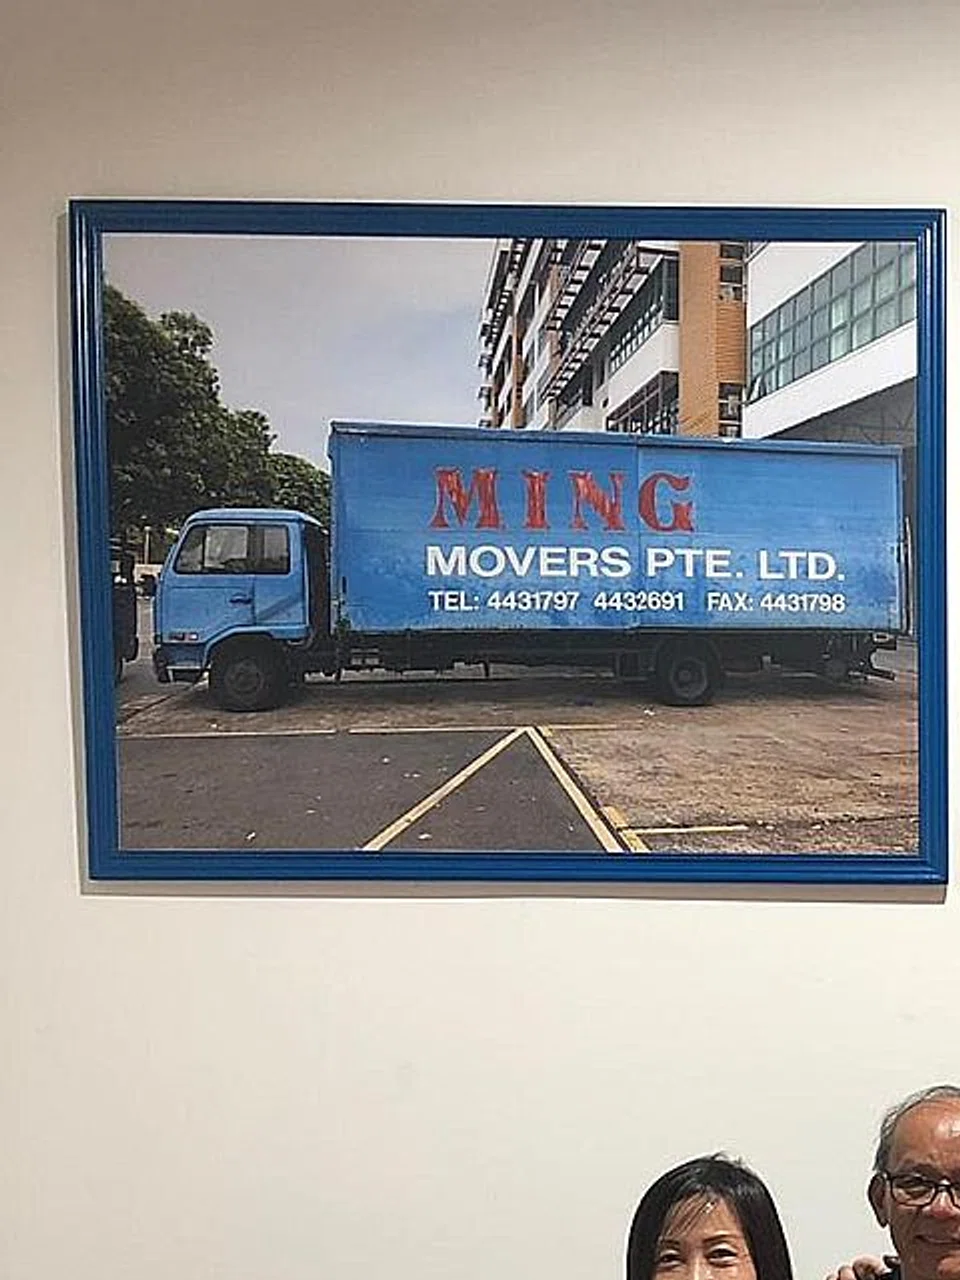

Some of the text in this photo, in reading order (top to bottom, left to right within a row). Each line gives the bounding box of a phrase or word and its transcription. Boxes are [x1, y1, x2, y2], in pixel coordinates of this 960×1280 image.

[427, 466, 696, 532] MING
[426, 545, 846, 581] MOVERS PTE. LTD.
[428, 591, 846, 613] TEL: 4431797 4432691 FAX: 4431798
